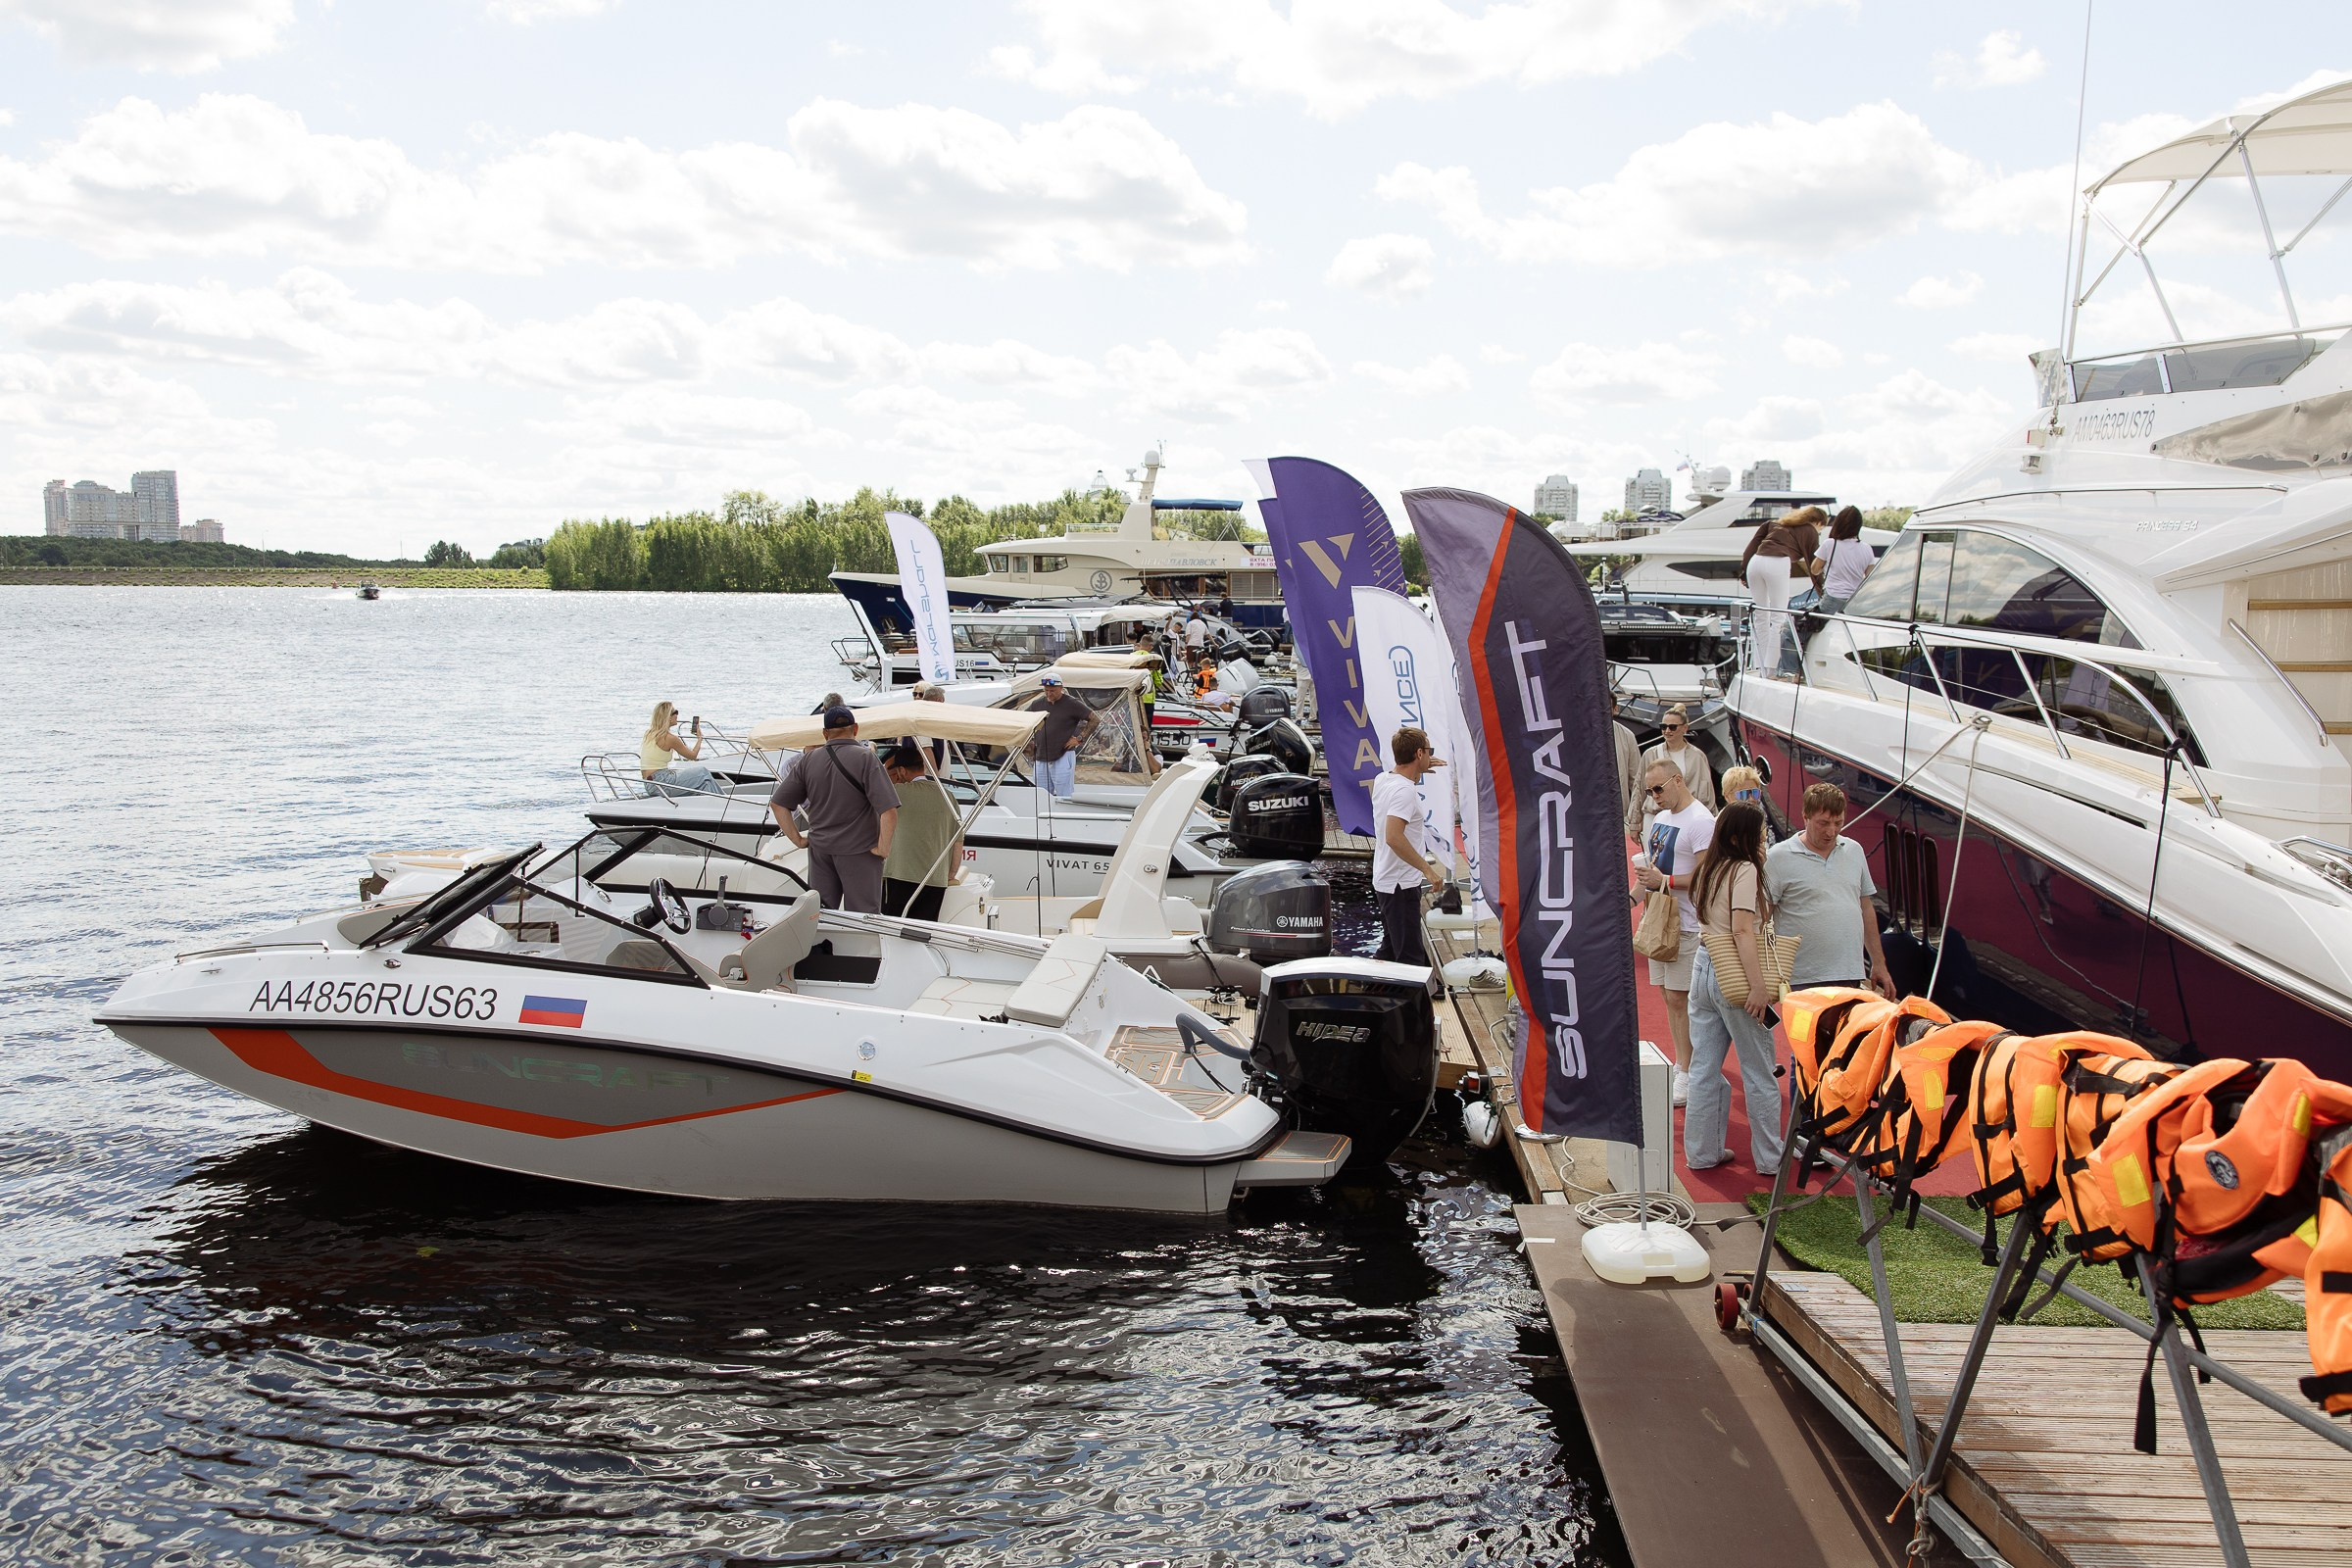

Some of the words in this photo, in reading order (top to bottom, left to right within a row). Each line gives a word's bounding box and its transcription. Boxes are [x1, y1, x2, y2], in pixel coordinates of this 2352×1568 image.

[1248, 796, 1309, 811] SUZUKI
[1504, 620, 1588, 1080] SUNCRAFT
[1047, 859, 1089, 870] VIVAT
[1289, 916, 1324, 927] YAMAHA
[249, 981, 498, 1020] AA4856RUS63
[401, 1042, 730, 1097] SUNCRAFT
